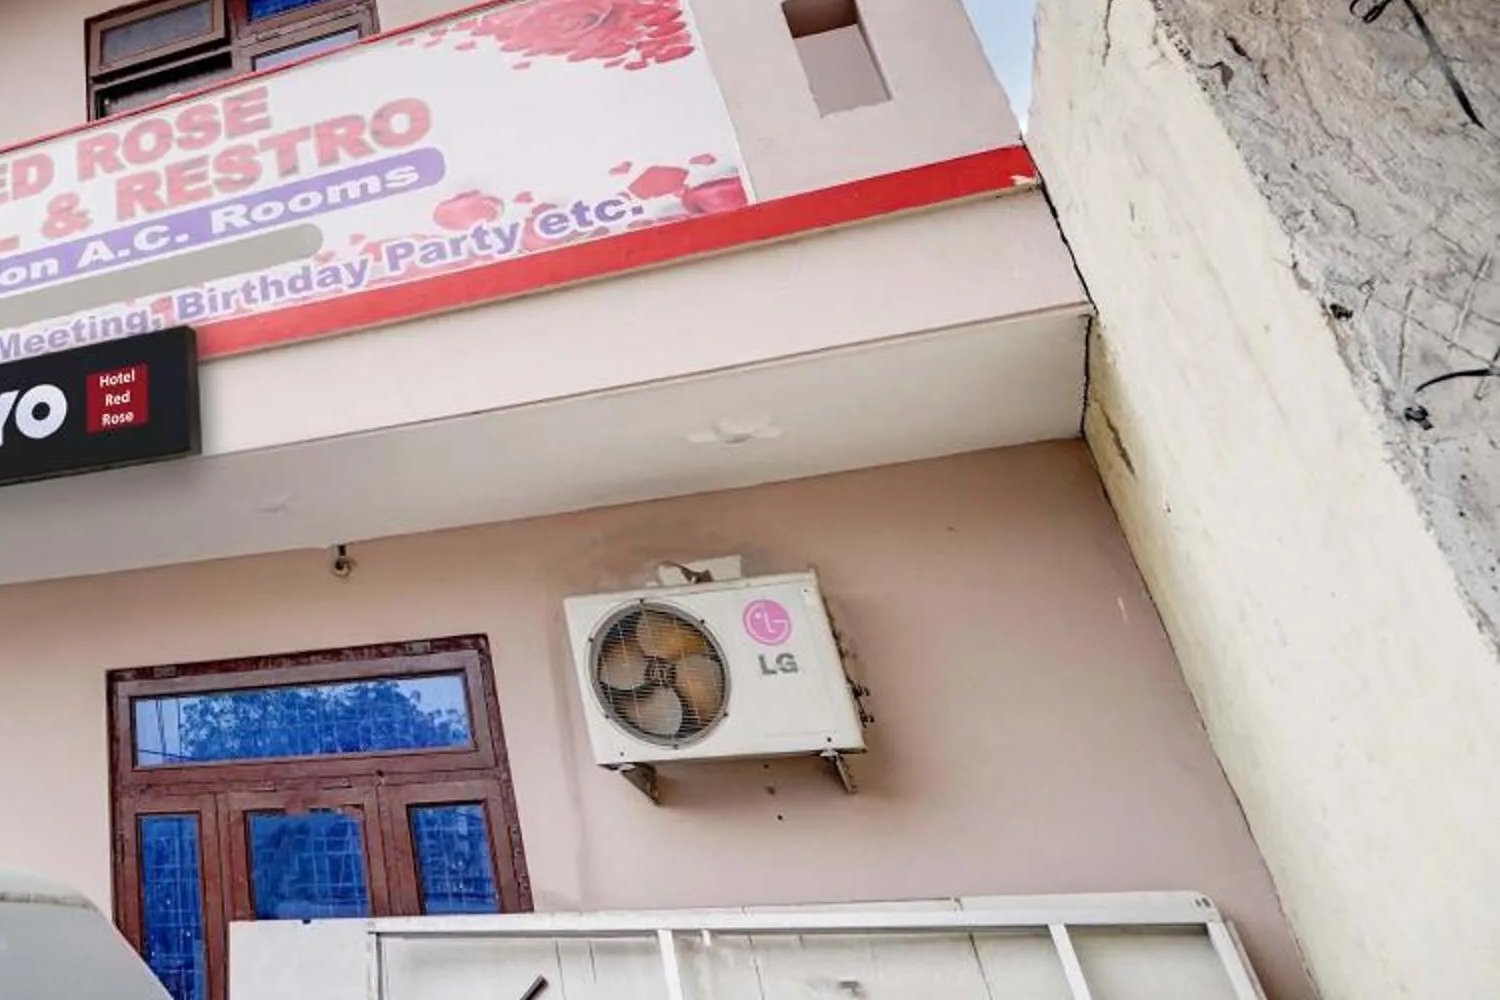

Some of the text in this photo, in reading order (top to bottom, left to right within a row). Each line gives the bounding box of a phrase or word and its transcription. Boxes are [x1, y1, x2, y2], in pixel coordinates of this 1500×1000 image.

[75, 86, 272, 181] ROSE
[40, 192, 93, 238] &
[114, 98, 431, 222] RESTRO
[77, 224, 189, 267] A.C.
[209, 163, 421, 235] Rooms
[177, 256, 370, 321] Birthday
[384, 220, 521, 273] Party
[537, 198, 645, 236] etc.
[99, 368, 136, 388] Hotel
[105, 391, 131, 407] Red
[101, 410, 134, 427] Rose
[757, 652, 799, 676] LG
